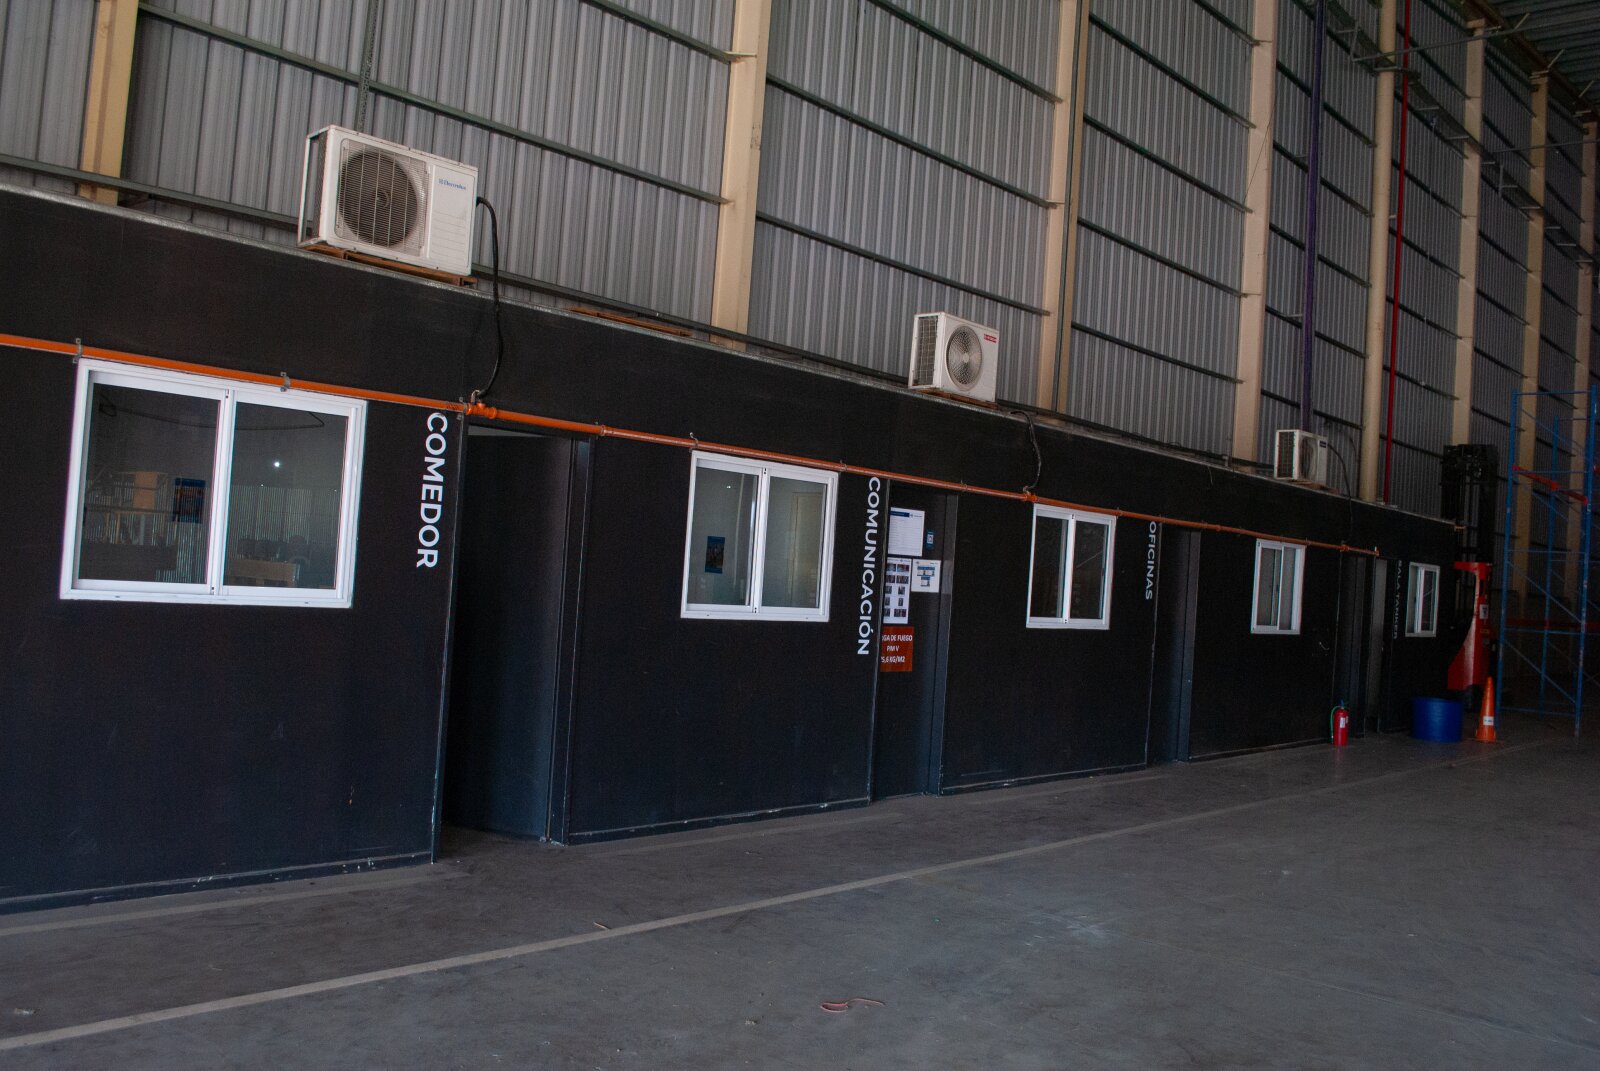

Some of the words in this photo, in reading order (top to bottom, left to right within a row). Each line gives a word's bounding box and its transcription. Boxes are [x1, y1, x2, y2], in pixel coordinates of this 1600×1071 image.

[416, 412, 448, 568] COMEDOR
[857, 476, 881, 655] COMUNICACIÓN
[1145, 521, 1157, 600] OFICINAS
